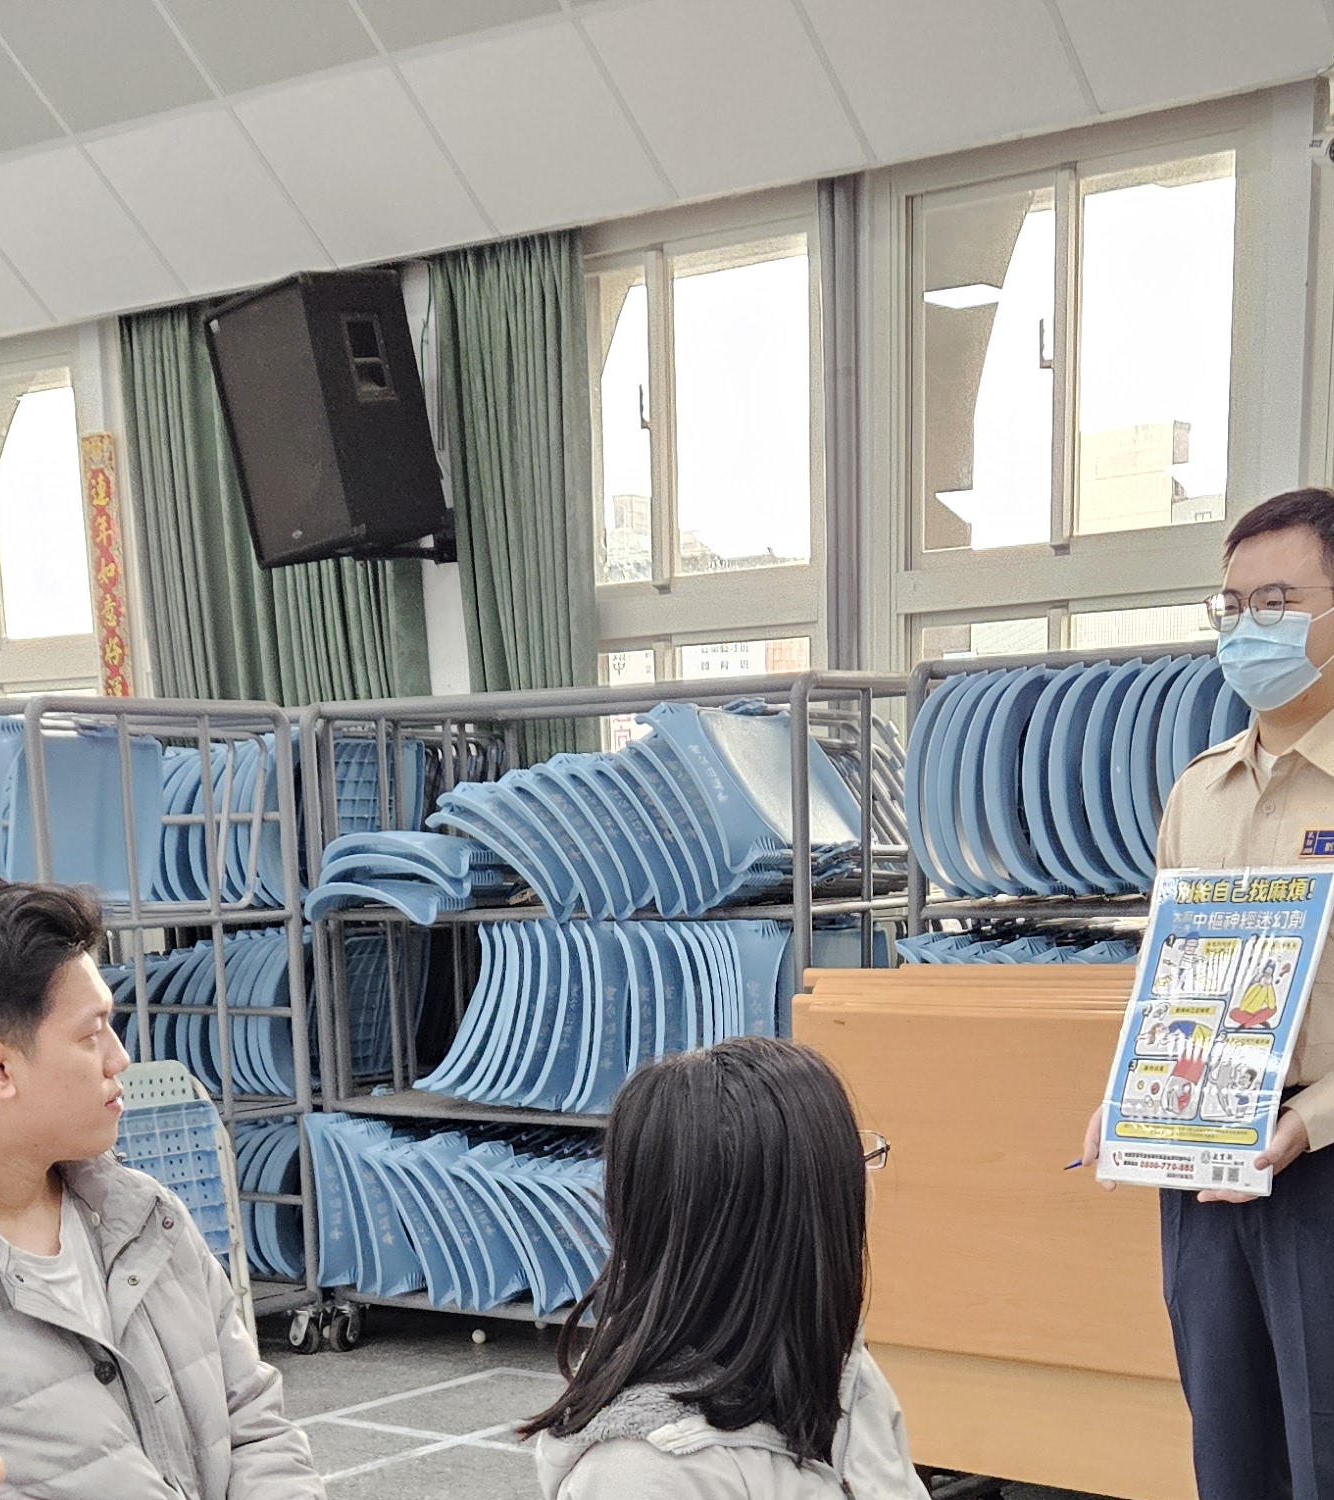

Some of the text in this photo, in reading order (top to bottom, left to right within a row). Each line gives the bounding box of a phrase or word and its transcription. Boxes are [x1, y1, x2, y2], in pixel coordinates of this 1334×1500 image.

[1193, 909, 1308, 931] 中樞神經迷幻劑
